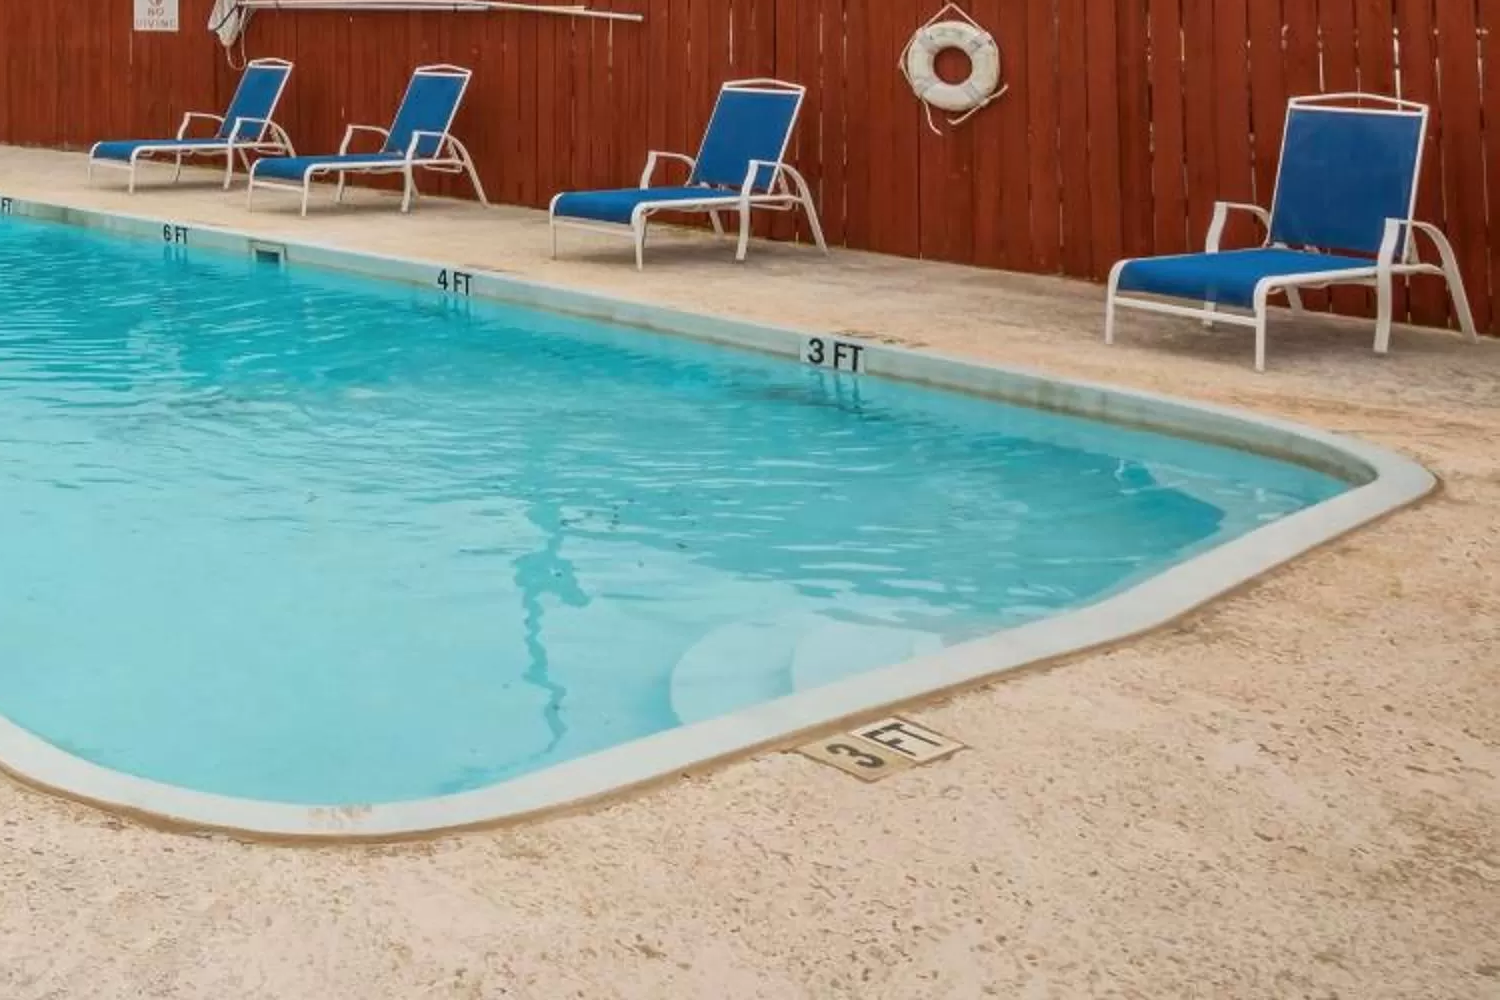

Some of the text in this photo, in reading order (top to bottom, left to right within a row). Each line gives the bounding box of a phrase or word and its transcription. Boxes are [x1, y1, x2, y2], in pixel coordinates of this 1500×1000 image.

[147, 6, 165, 17] NO
[2, 197, 14, 215] FT
[163, 224, 189, 244] 6 FT
[437, 268, 474, 296] 4 FT
[807, 338, 864, 372] 3 FT
[825, 722, 942, 768] 3 FT
